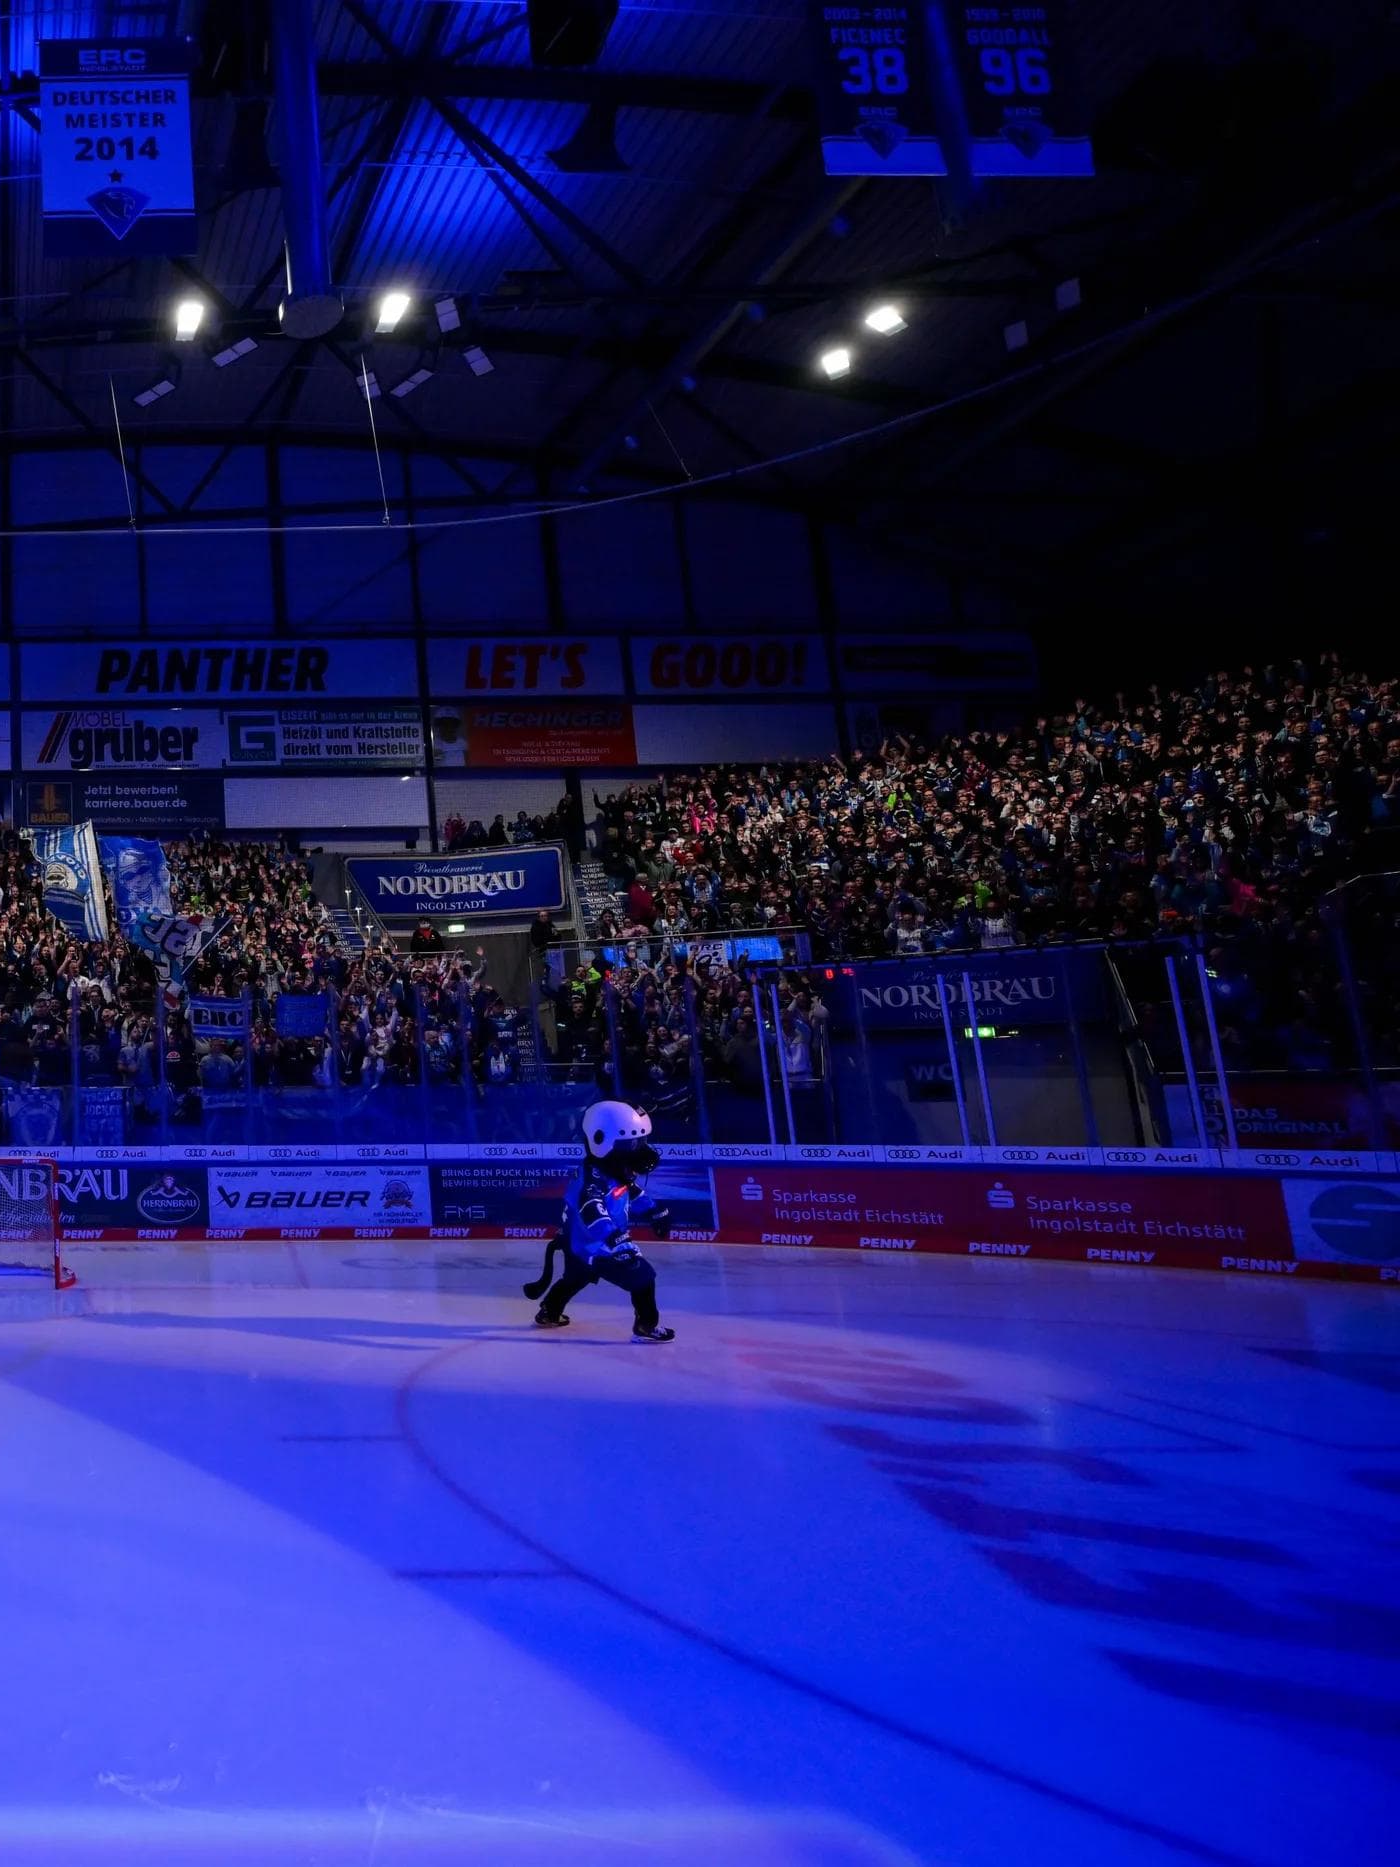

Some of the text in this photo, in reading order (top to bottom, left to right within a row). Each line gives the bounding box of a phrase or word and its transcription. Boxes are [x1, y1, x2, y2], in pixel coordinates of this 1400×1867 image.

[78, 48, 147, 65] ERC
[839, 48, 910, 96] 38
[979, 49, 1052, 96] 96
[52, 89, 177, 106] DEUTSCHER
[65, 112, 167, 128] MEISTER
[73, 136, 160, 161] 2014
[95, 648, 329, 693] PANTHER
[464, 643, 588, 689] LET'S
[73, 712, 130, 728] MÖBEL
[282, 726, 420, 740] Heizöl und Kraftstoffe
[69, 718, 198, 769] gruber
[283, 742, 421, 756] direkt vom Hersteller
[115, 784, 178, 795] bewerben!
[84, 798, 188, 809] karriere.bauer.de
[377, 869, 527, 900] NORDBRÄU
[416, 899, 488, 912] INGOLSTADT
[860, 976, 1056, 1010] NORDBRÄU
[1233, 1107, 1279, 1120] DAS
[1236, 1120, 1348, 1135] ORIGINAL
[35, 1150, 59, 1158] Audi
[122, 1150, 147, 1158] Audi
[211, 1149, 236, 1157] Audi
[295, 1149, 320, 1157] Audi
[384, 1148, 408, 1156] Audi
[511, 1148, 537, 1156] Audi
[668, 1148, 697, 1156] Audi
[742, 1147, 773, 1157] Audi
[837, 1148, 870, 1158] Audi
[927, 1150, 963, 1160] Audi
[1046, 1151, 1086, 1161] Audi
[1154, 1152, 1198, 1163] Audi
[1309, 1154, 1360, 1167] Audi
[441, 1168, 569, 1177] BRING DEN PUCK INS NETZ
[482, 1179, 503, 1188] DICH
[503, 1178, 541, 1187] JETZT!
[772, 1188, 857, 1205] Sparkasse
[1025, 1196, 1133, 1214] Sparkasse
[774, 1206, 945, 1225] Ingolstadt Eichstätt
[63, 1229, 103, 1239] PENNY
[137, 1229, 178, 1239] PENNY
[206, 1228, 248, 1239] PENNY
[280, 1228, 321, 1239] PENNY
[354, 1228, 395, 1238] PENNY
[429, 1227, 471, 1238] PENNY
[504, 1227, 546, 1238] PENNY
[1027, 1216, 1246, 1240] Ingolstadt Eichstätt
[669, 1230, 719, 1241] PENNY
[761, 1233, 814, 1246] PENNY
[859, 1236, 917, 1250] PENNY
[968, 1241, 1032, 1257] PENNY
[1086, 1247, 1157, 1264] PENNY
[1220, 1255, 1300, 1273] PENNY
